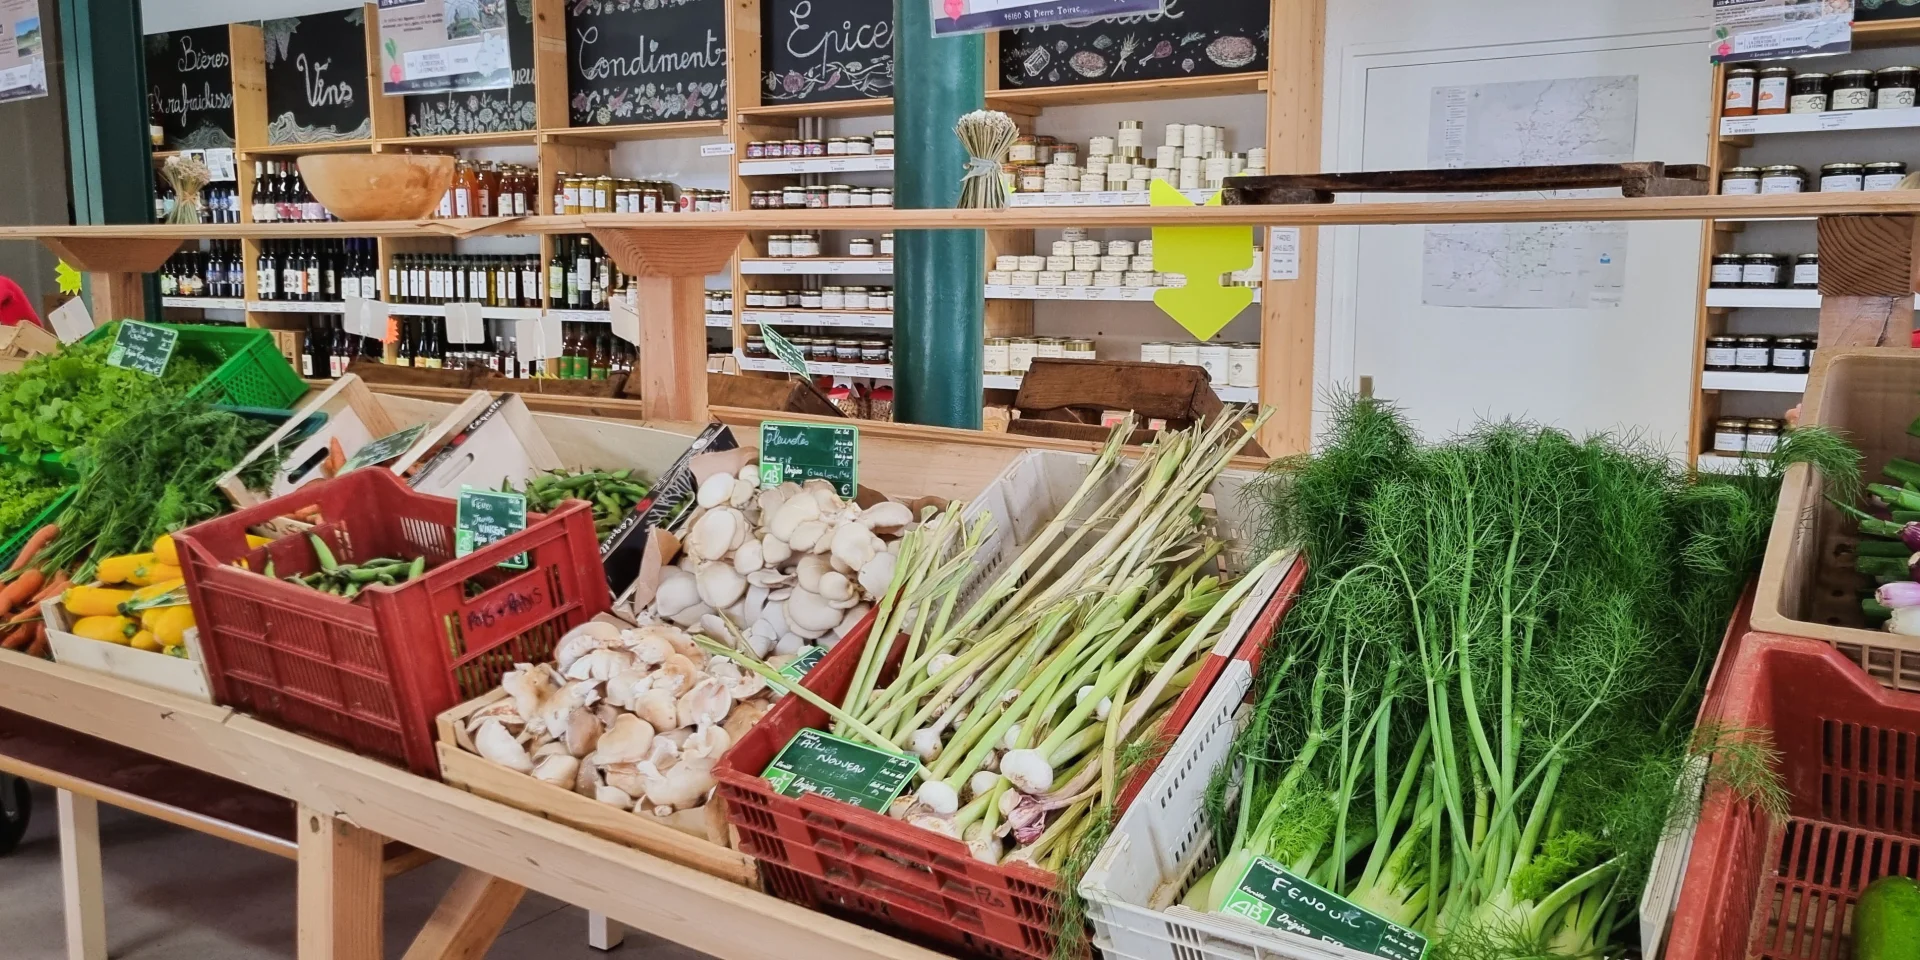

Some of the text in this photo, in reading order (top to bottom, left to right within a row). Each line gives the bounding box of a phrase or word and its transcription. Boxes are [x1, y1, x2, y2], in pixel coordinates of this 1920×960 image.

[1024, 11, 1032, 19] St
[1034, 9, 1054, 18] Pierre
[1058, 6, 1081, 15] Toirac
[178, 35, 229, 72] Bières
[787, 1, 894, 79] Epice
[296, 52, 353, 107] Vins
[166, 81, 233, 127] rafraichisse
[763, 468, 780, 484] AB
[784, 464, 803, 478] Origine
[600, 517, 633, 553] Coquett
[816, 754, 866, 774] NOUVEAU
[792, 776, 818, 794] Origine
[1229, 900, 1263, 921] AB
[1276, 911, 1311, 935] Origine
